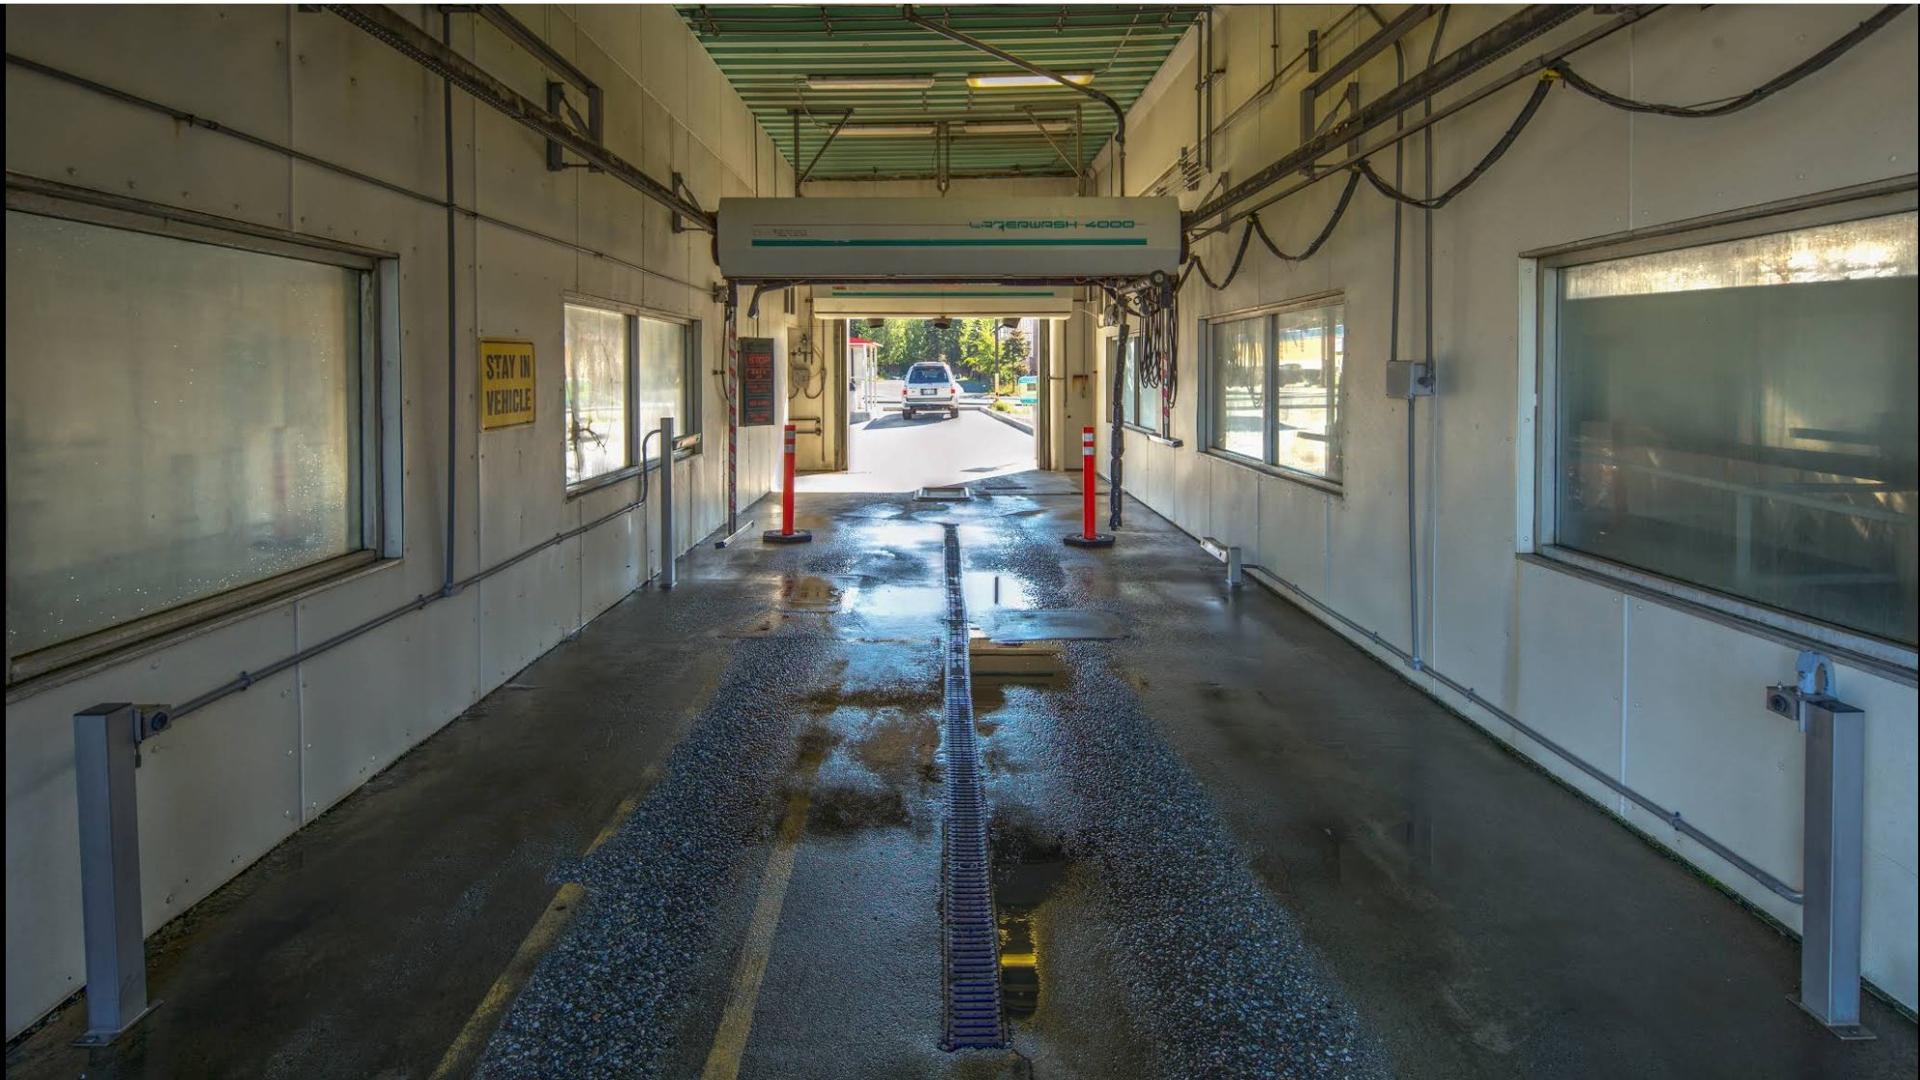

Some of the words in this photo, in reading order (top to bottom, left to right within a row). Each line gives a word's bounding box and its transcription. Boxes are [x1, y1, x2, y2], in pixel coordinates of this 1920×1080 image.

[1084, 220, 1136, 230] 4000
[486, 354, 515, 380] STAY
[520, 354, 530, 379] IN
[486, 388, 531, 416] VEHICLE
